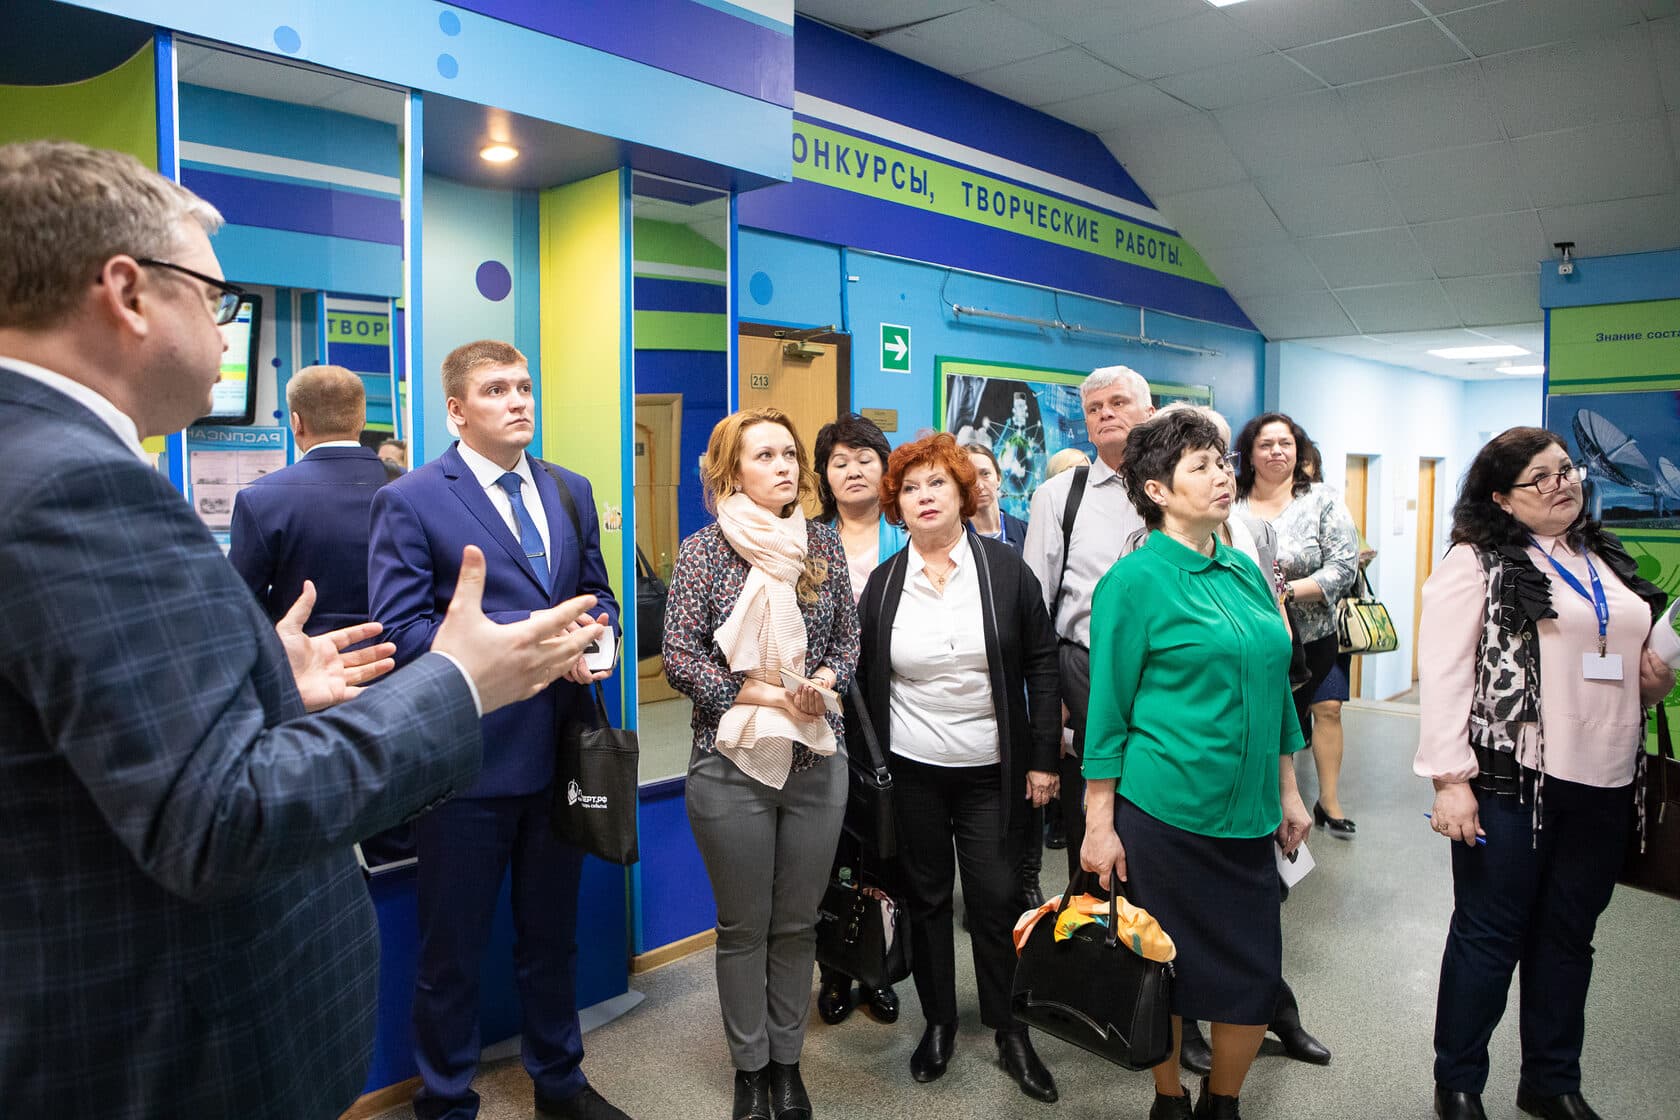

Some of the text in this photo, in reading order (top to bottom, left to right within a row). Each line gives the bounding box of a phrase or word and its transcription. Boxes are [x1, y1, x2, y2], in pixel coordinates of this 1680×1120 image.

[792, 132, 1183, 268] ОНКУРСЫ, ТВОРЧЕСКИЕ РАБОТЫ.
[328, 319, 389, 336] ТВОР
[1596, 332, 1642, 342] Знание
[753, 375, 769, 387] 213
